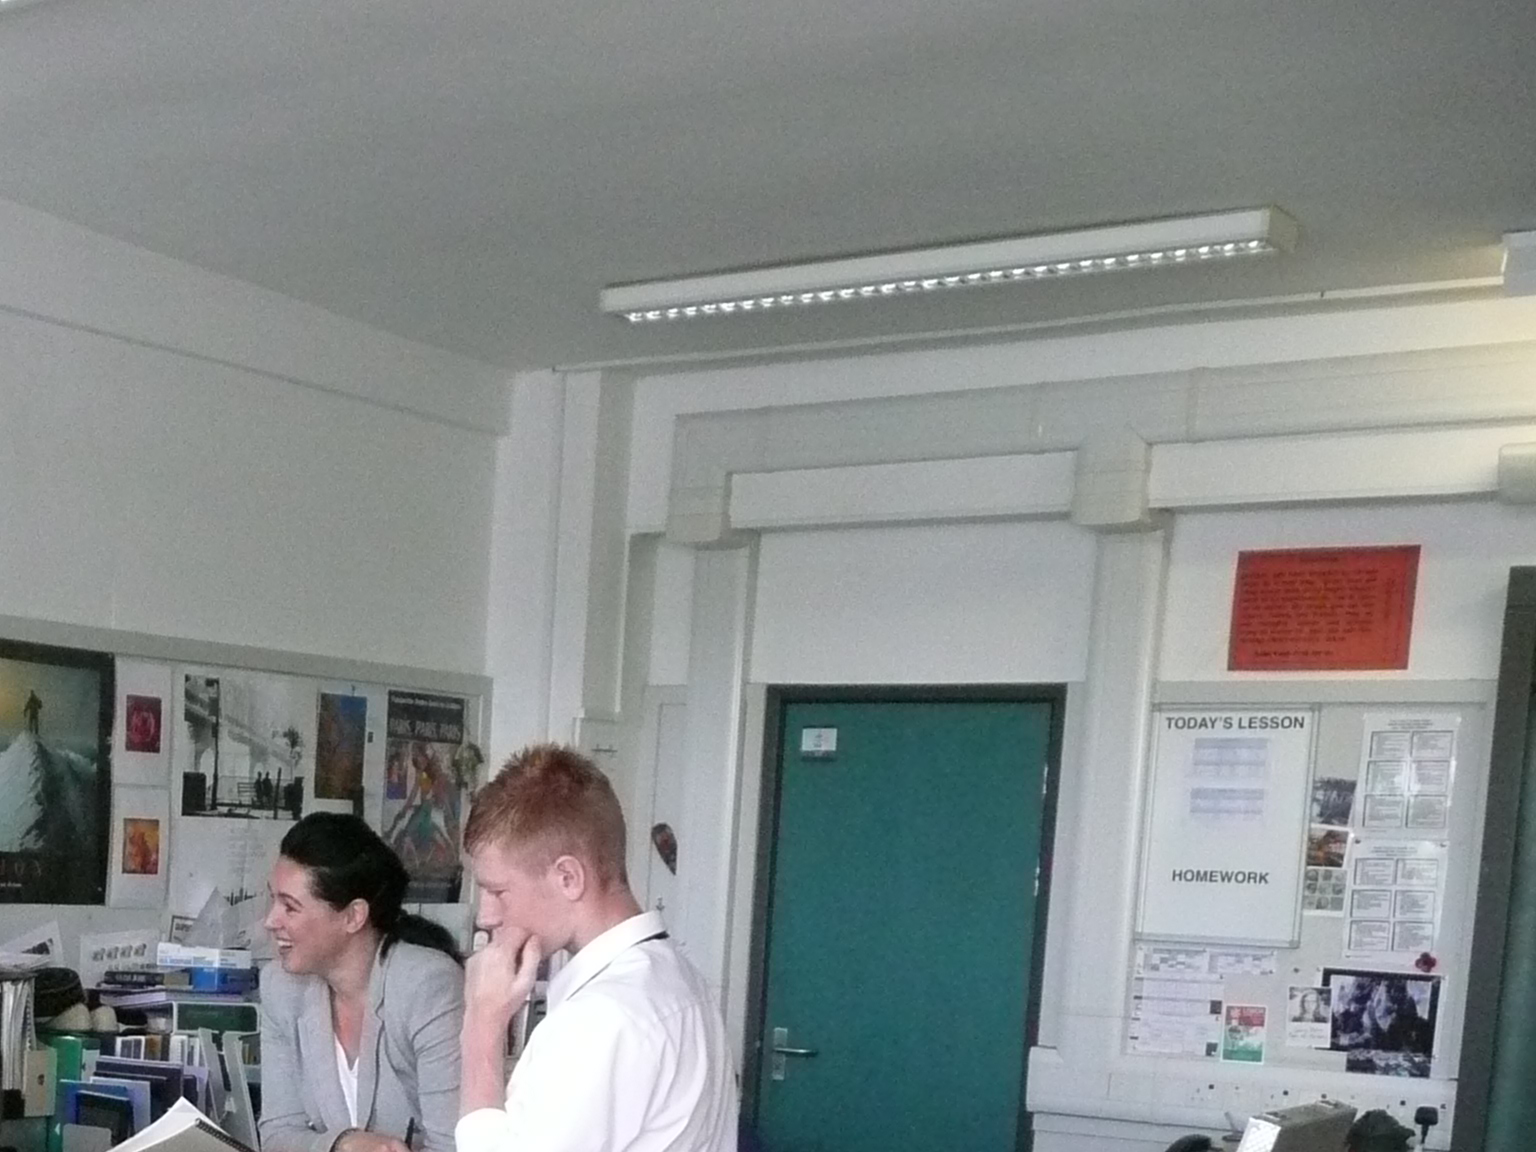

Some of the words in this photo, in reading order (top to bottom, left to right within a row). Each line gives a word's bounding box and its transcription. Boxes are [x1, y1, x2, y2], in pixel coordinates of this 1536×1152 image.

[1165, 716, 1233, 730] TODAY'S
[1238, 716, 1305, 729] LESSON
[1172, 869, 1270, 885] HOMEWORK
